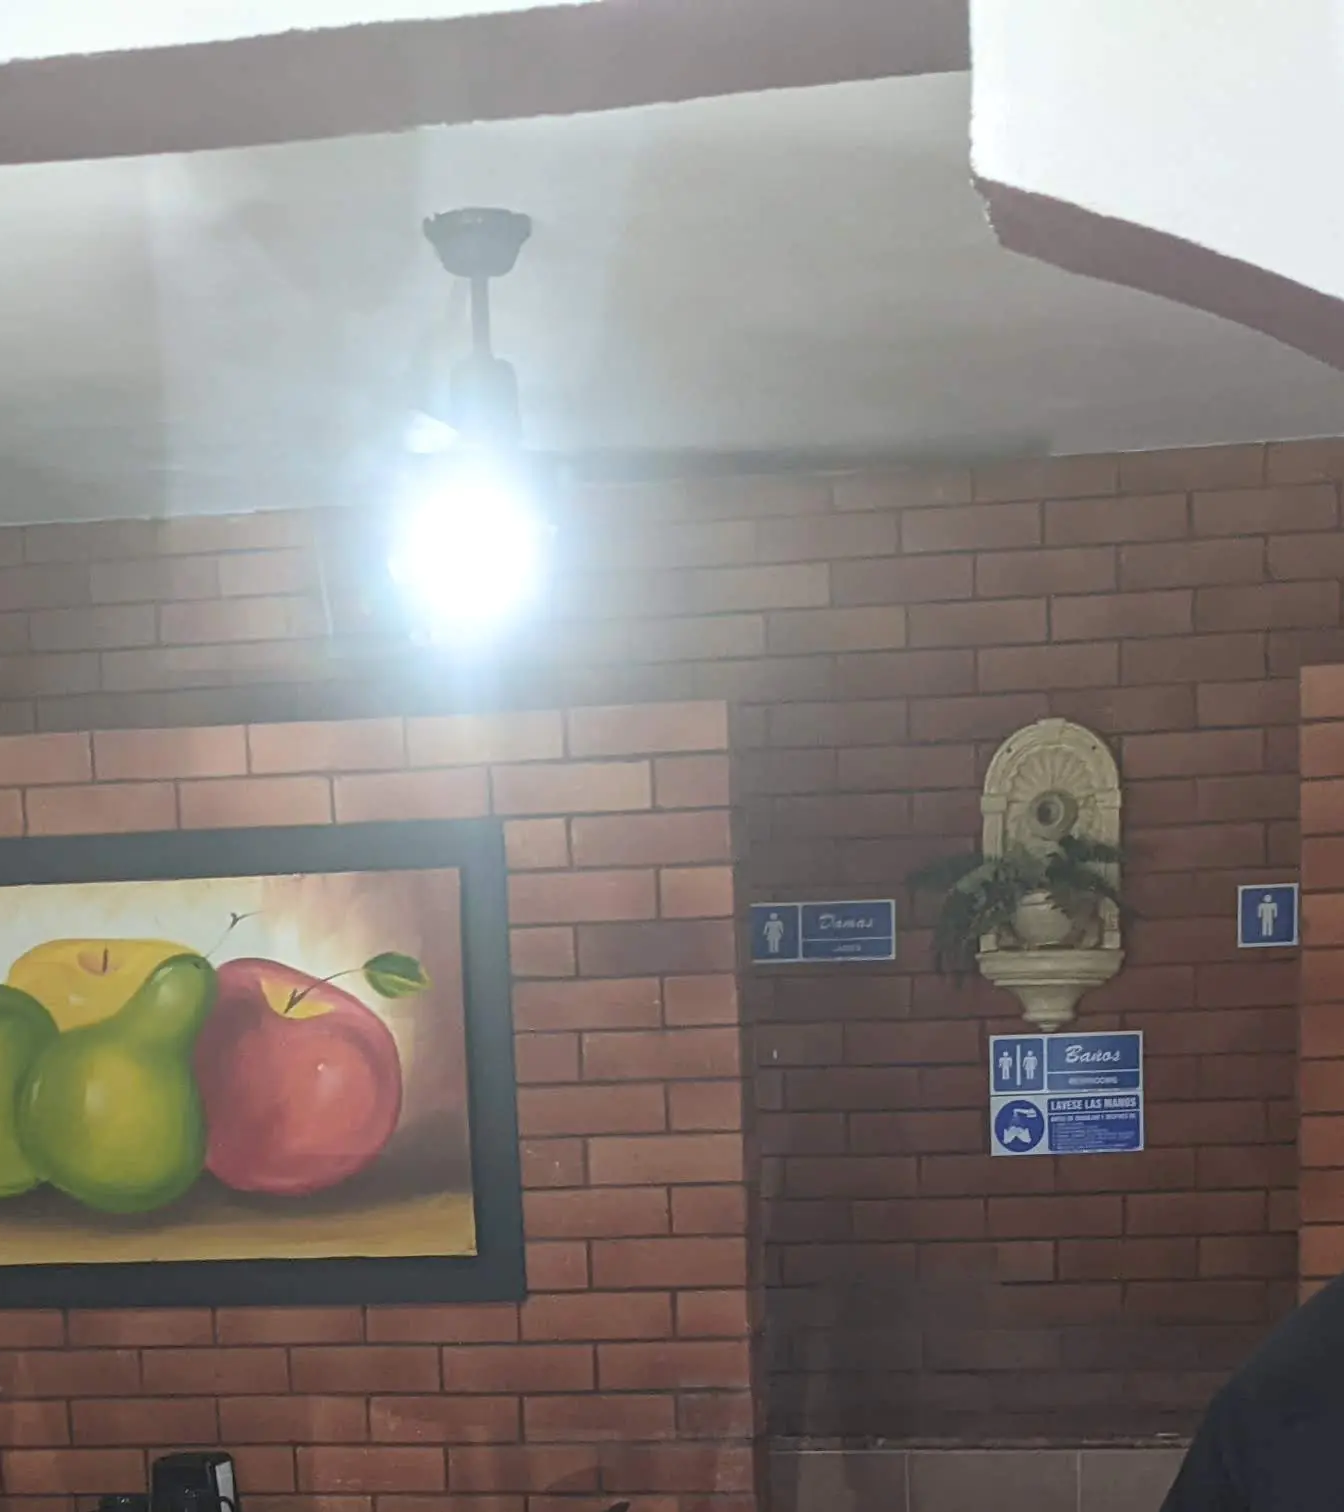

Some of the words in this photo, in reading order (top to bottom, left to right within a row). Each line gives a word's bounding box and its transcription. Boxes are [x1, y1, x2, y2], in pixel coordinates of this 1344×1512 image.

[819, 912, 874, 931] Damas
[1084, 1098, 1102, 1109] LAS
[1103, 1097, 1137, 1108] MANOS
